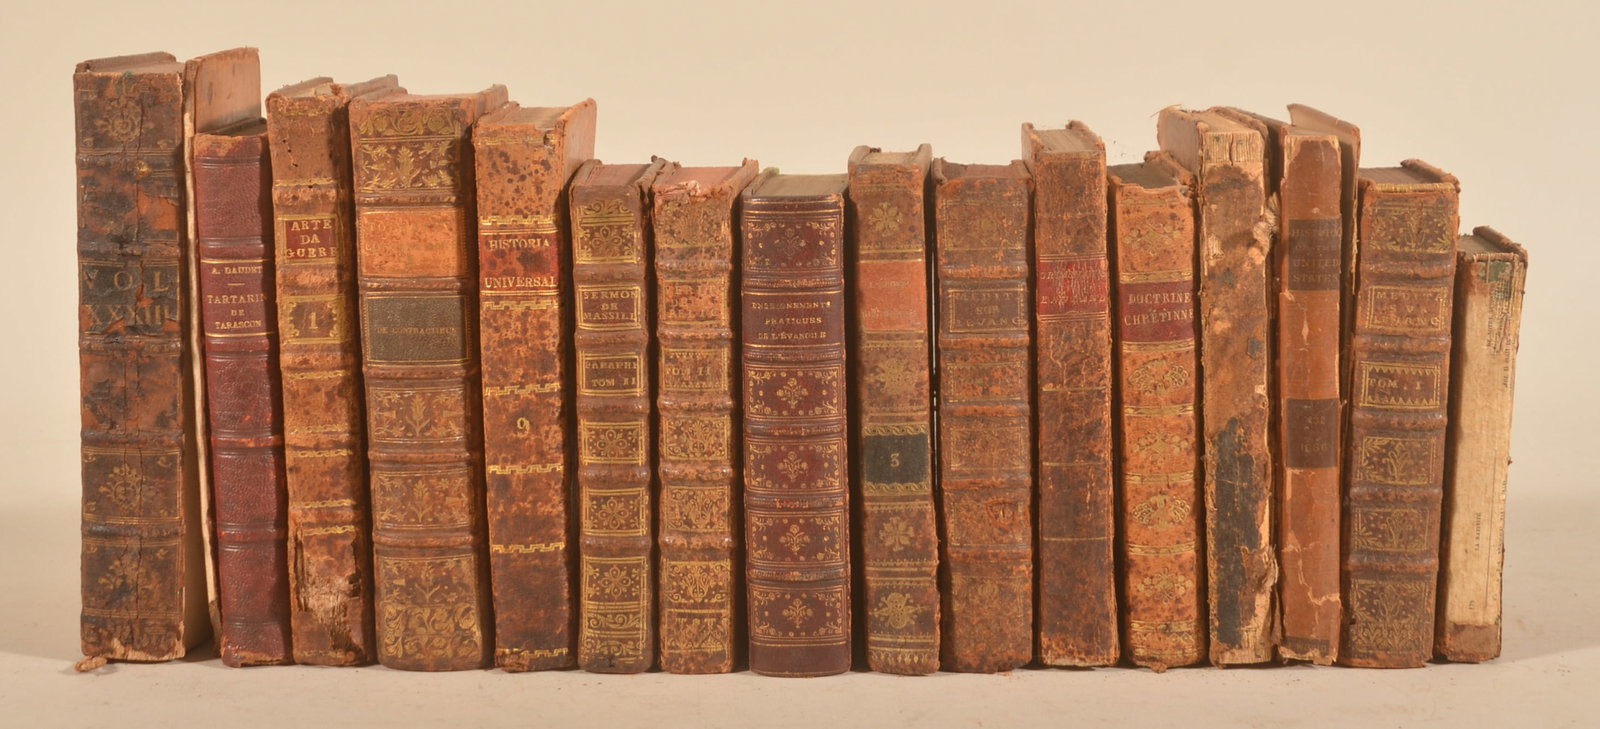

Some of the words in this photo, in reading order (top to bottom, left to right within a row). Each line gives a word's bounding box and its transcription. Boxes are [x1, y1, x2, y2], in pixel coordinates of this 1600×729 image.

[291, 219, 332, 231] ARTE
[300, 234, 320, 245] DA
[488, 238, 550, 250] HISTORIA
[224, 265, 263, 274] DAUDET
[83, 268, 169, 291] VOL
[484, 275, 557, 288] UNIVERSAL
[1128, 292, 1191, 304] DOCTRINE
[601, 302, 618, 311] DE
[215, 320, 262, 330] TARASCON
[308, 312, 318, 330] 1
[592, 378, 615, 387] TOM
[623, 377, 637, 386] II
[516, 417, 530, 434] 9
[890, 453, 899, 467] 3
